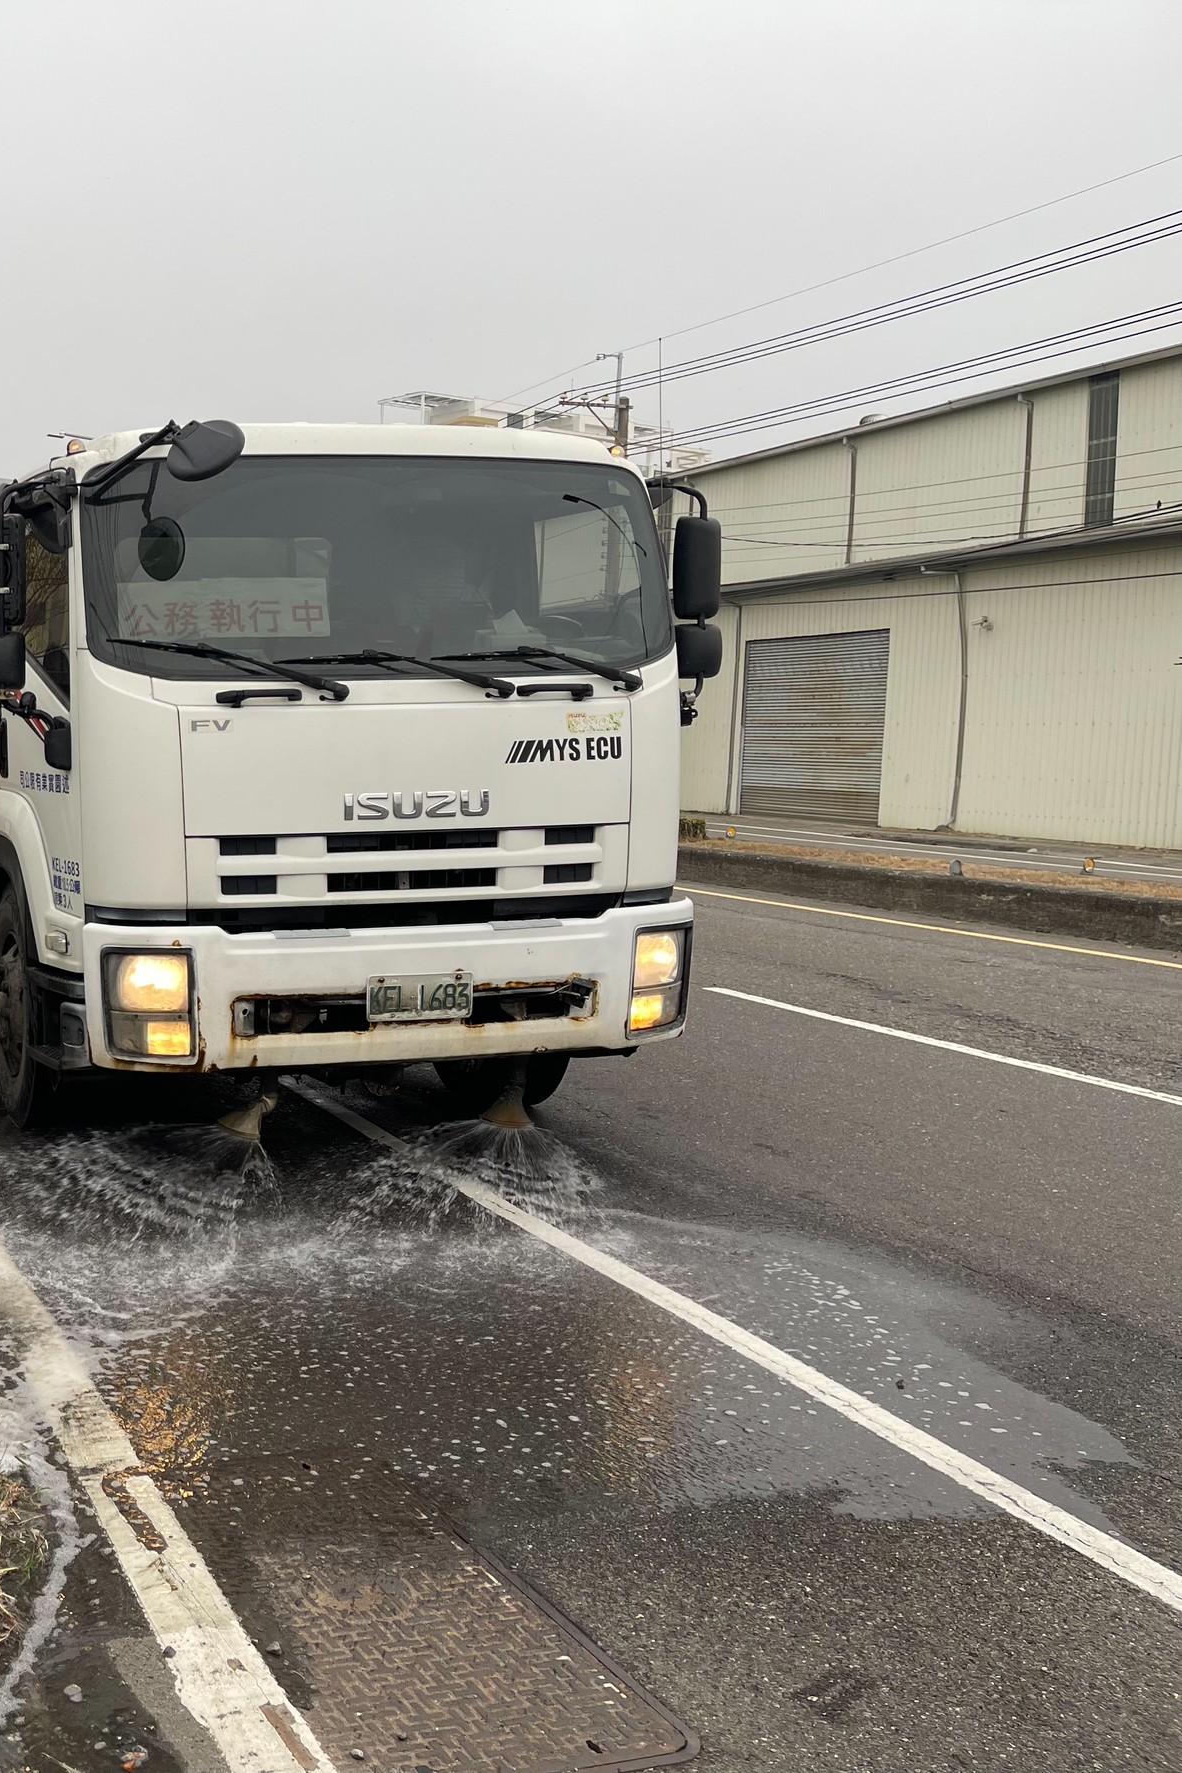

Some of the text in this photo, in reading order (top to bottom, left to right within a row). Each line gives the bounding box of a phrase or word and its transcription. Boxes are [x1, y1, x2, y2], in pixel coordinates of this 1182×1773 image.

[125, 599, 325, 637] 公務執行中
[191, 720, 231, 732] FV
[586, 736, 622, 761] ECU
[344, 789, 490, 821] ISUZU
[51, 856, 80, 877] KEL-1683
